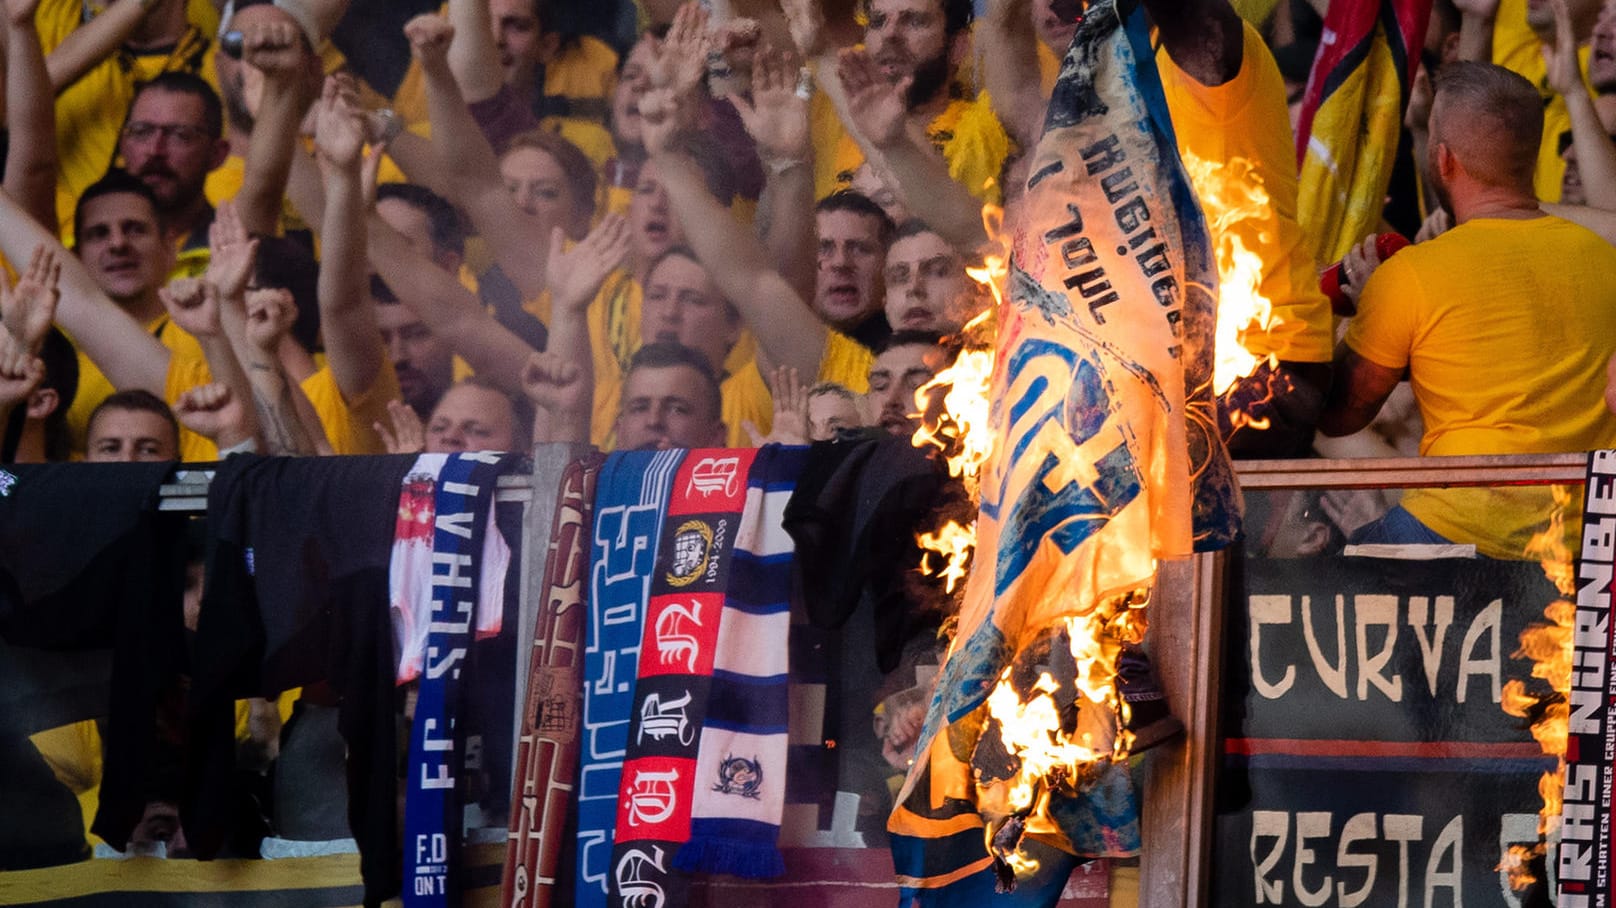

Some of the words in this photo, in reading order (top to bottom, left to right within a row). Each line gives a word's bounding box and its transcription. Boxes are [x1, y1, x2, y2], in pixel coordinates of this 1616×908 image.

[1248, 593, 1503, 704] CURVA
[1602, 766, 1613, 807] EINER
[1250, 810, 1463, 908] RESTA
[1597, 813, 1610, 887] SCHATTEN
